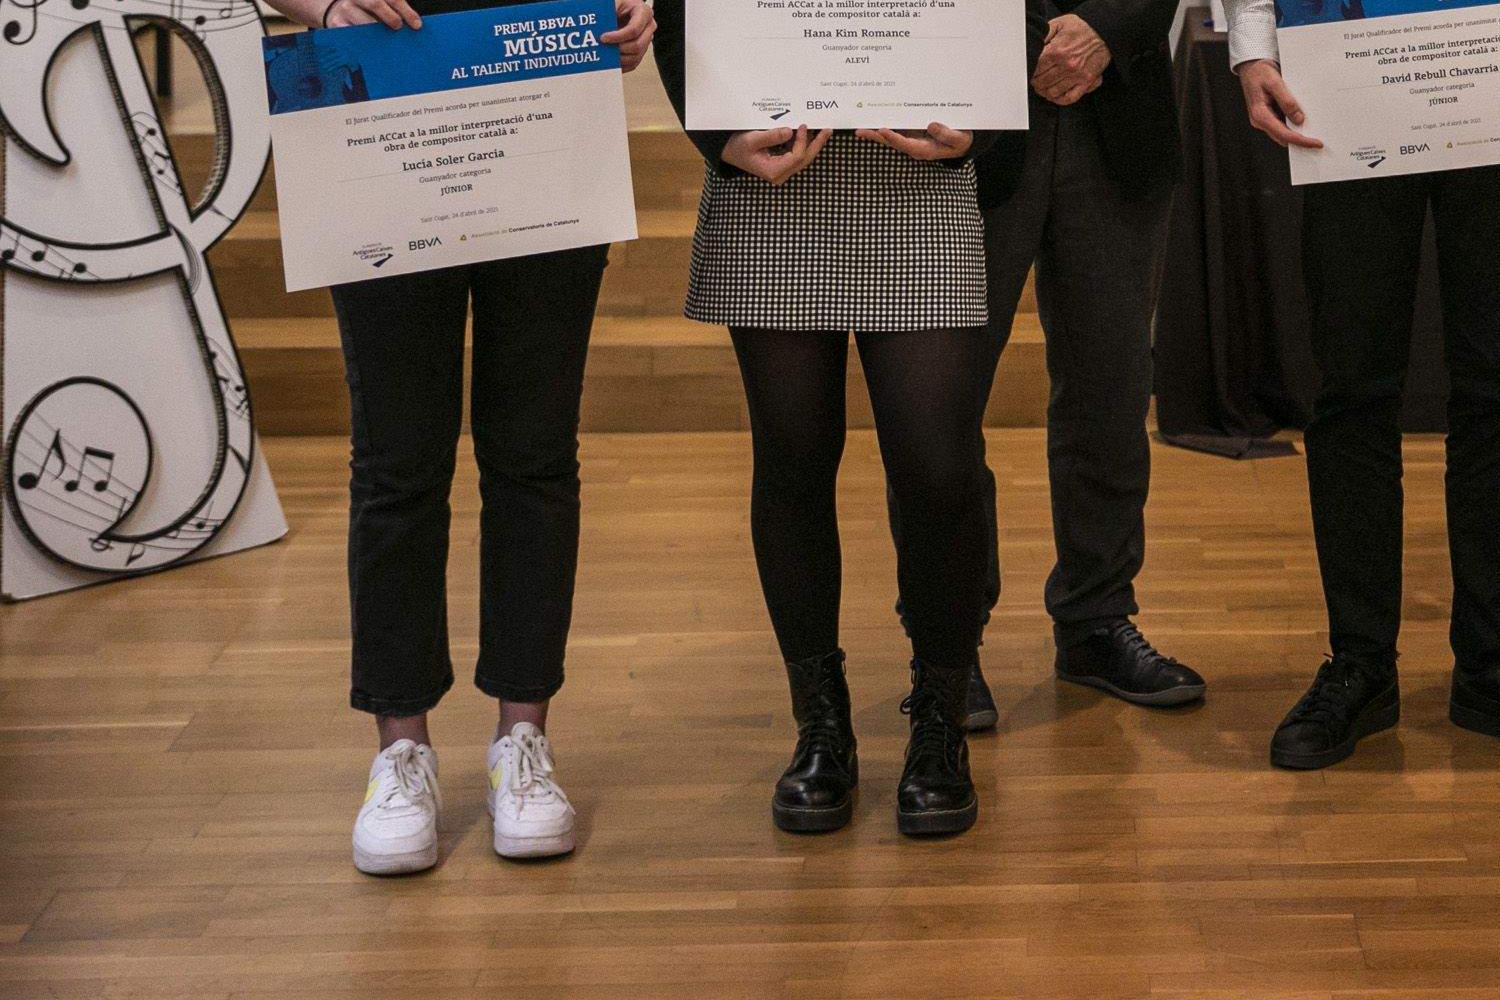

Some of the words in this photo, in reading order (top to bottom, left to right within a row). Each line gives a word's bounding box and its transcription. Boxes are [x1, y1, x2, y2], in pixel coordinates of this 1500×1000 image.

[757, 0, 785, 8] Premi
[787, 0, 815, 8] ACCat
[825, 0, 834, 8] la
[836, 0, 865, 8] millor
[867, 0, 928, 9] interpretació
[791, 10, 813, 18] obra
[828, 10, 880, 19] compositor
[493, 20, 537, 36] PREMI
[538, 16, 576, 31] BBVA
[578, 13, 596, 26] DE
[803, 29, 832, 38] Hana
[835, 28, 858, 38] Kim
[861, 28, 910, 38] Romance
[503, 29, 599, 57] MÚSICA
[1345, 49, 1371, 59] Premi
[1372, 47, 1398, 56] ACCat
[1407, 44, 1416, 52] la
[1418, 42, 1445, 51] millor
[451, 67, 469, 80] AL
[470, 60, 521, 77] TALENT
[524, 50, 600, 70] INDIVIDUAL
[1377, 57, 1398, 65] obra
[1399, 54, 1410, 63] de
[1411, 50, 1461, 62] compositor
[1381, 72, 1412, 84] David
[1414, 68, 1447, 81] Rebull
[806, 100, 839, 110] BBVA
[346, 135, 376, 147] Premi
[378, 132, 407, 142] ACCat
[417, 128, 427, 137] la
[428, 124, 459, 135] millor
[460, 115, 524, 131] interpretació
[383, 143, 406, 152] obra
[408, 140, 419, 149] de
[421, 133, 476, 147] compositor
[1399, 142, 1431, 155] BBVA
[435, 155, 465, 167] Soler
[408, 236, 442, 251] BBVA
